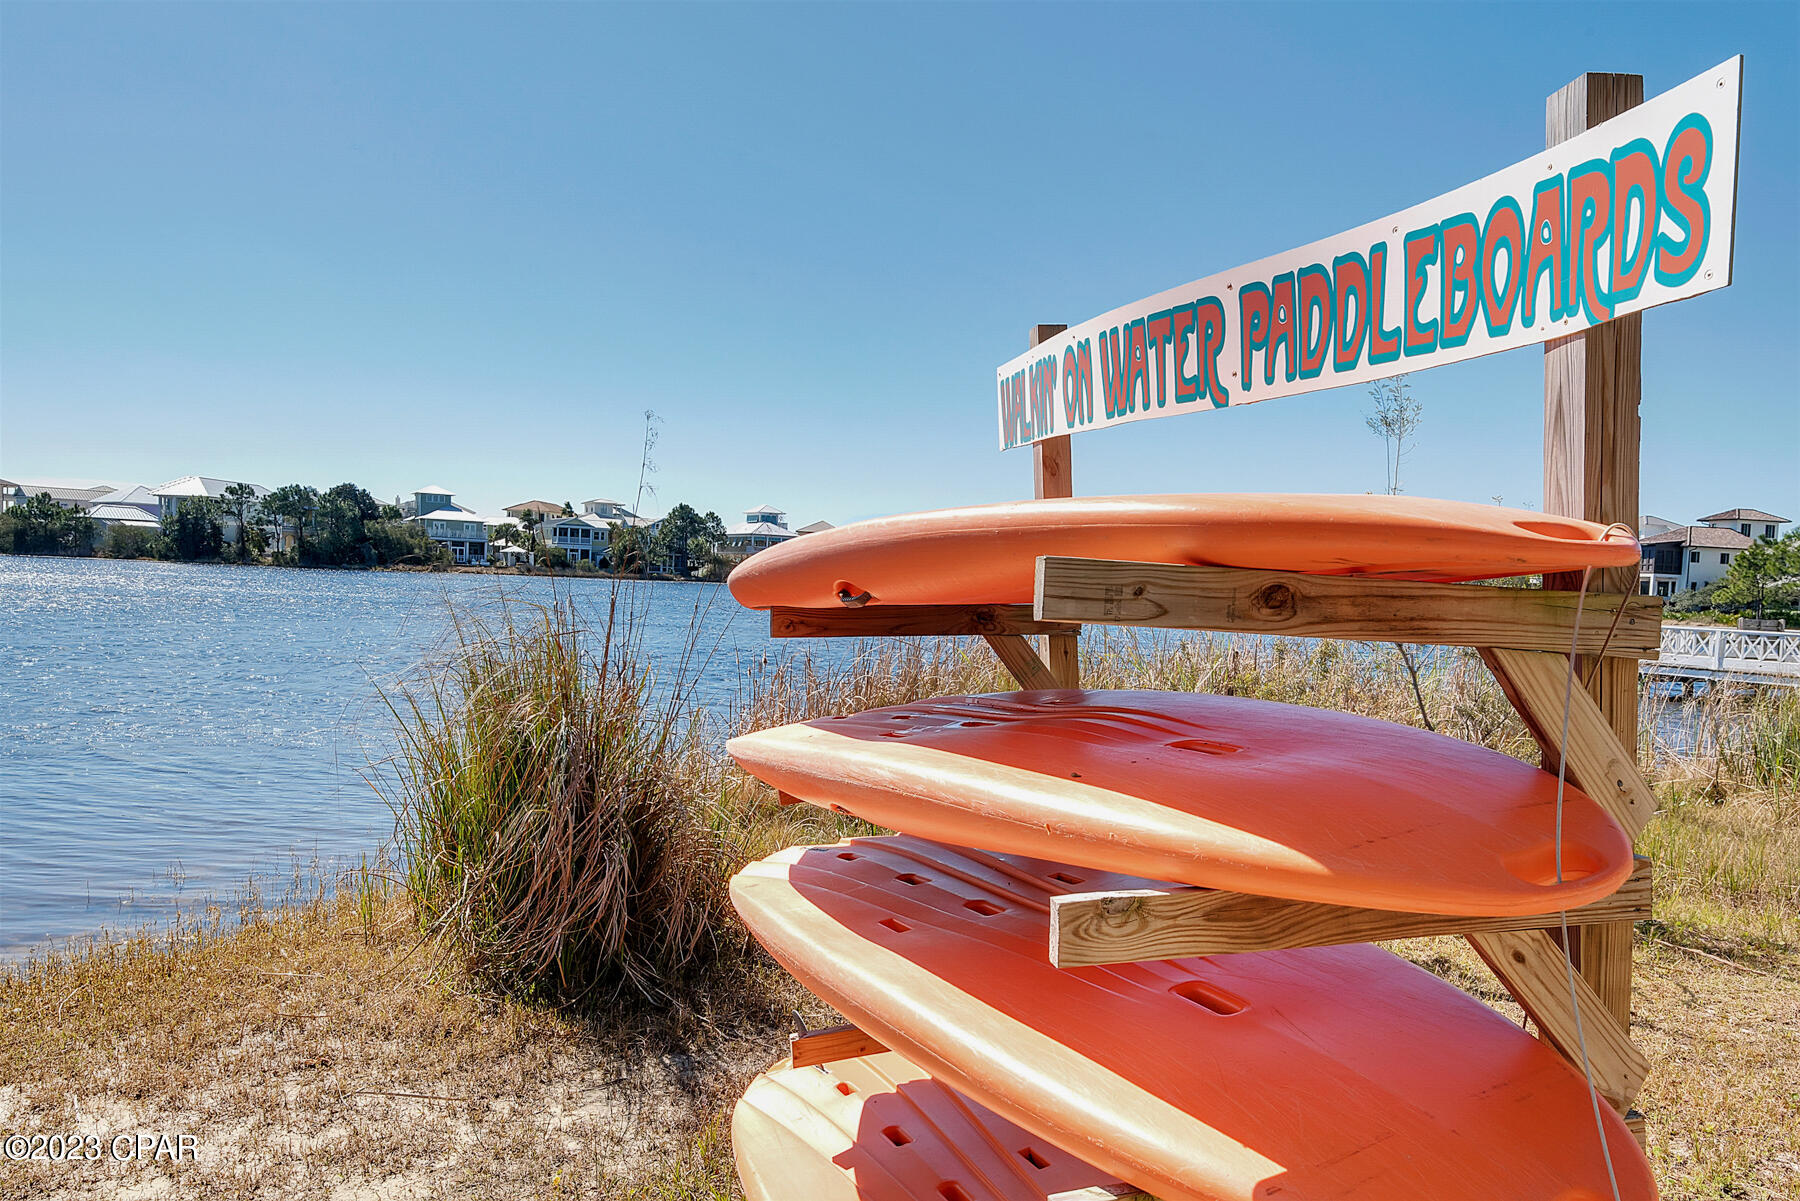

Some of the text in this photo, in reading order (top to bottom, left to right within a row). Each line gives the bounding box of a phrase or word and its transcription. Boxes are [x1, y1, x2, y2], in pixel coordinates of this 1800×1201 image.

[1000, 112, 1713, 449] WALKIN' ON WATER PADDLEBOARDS
